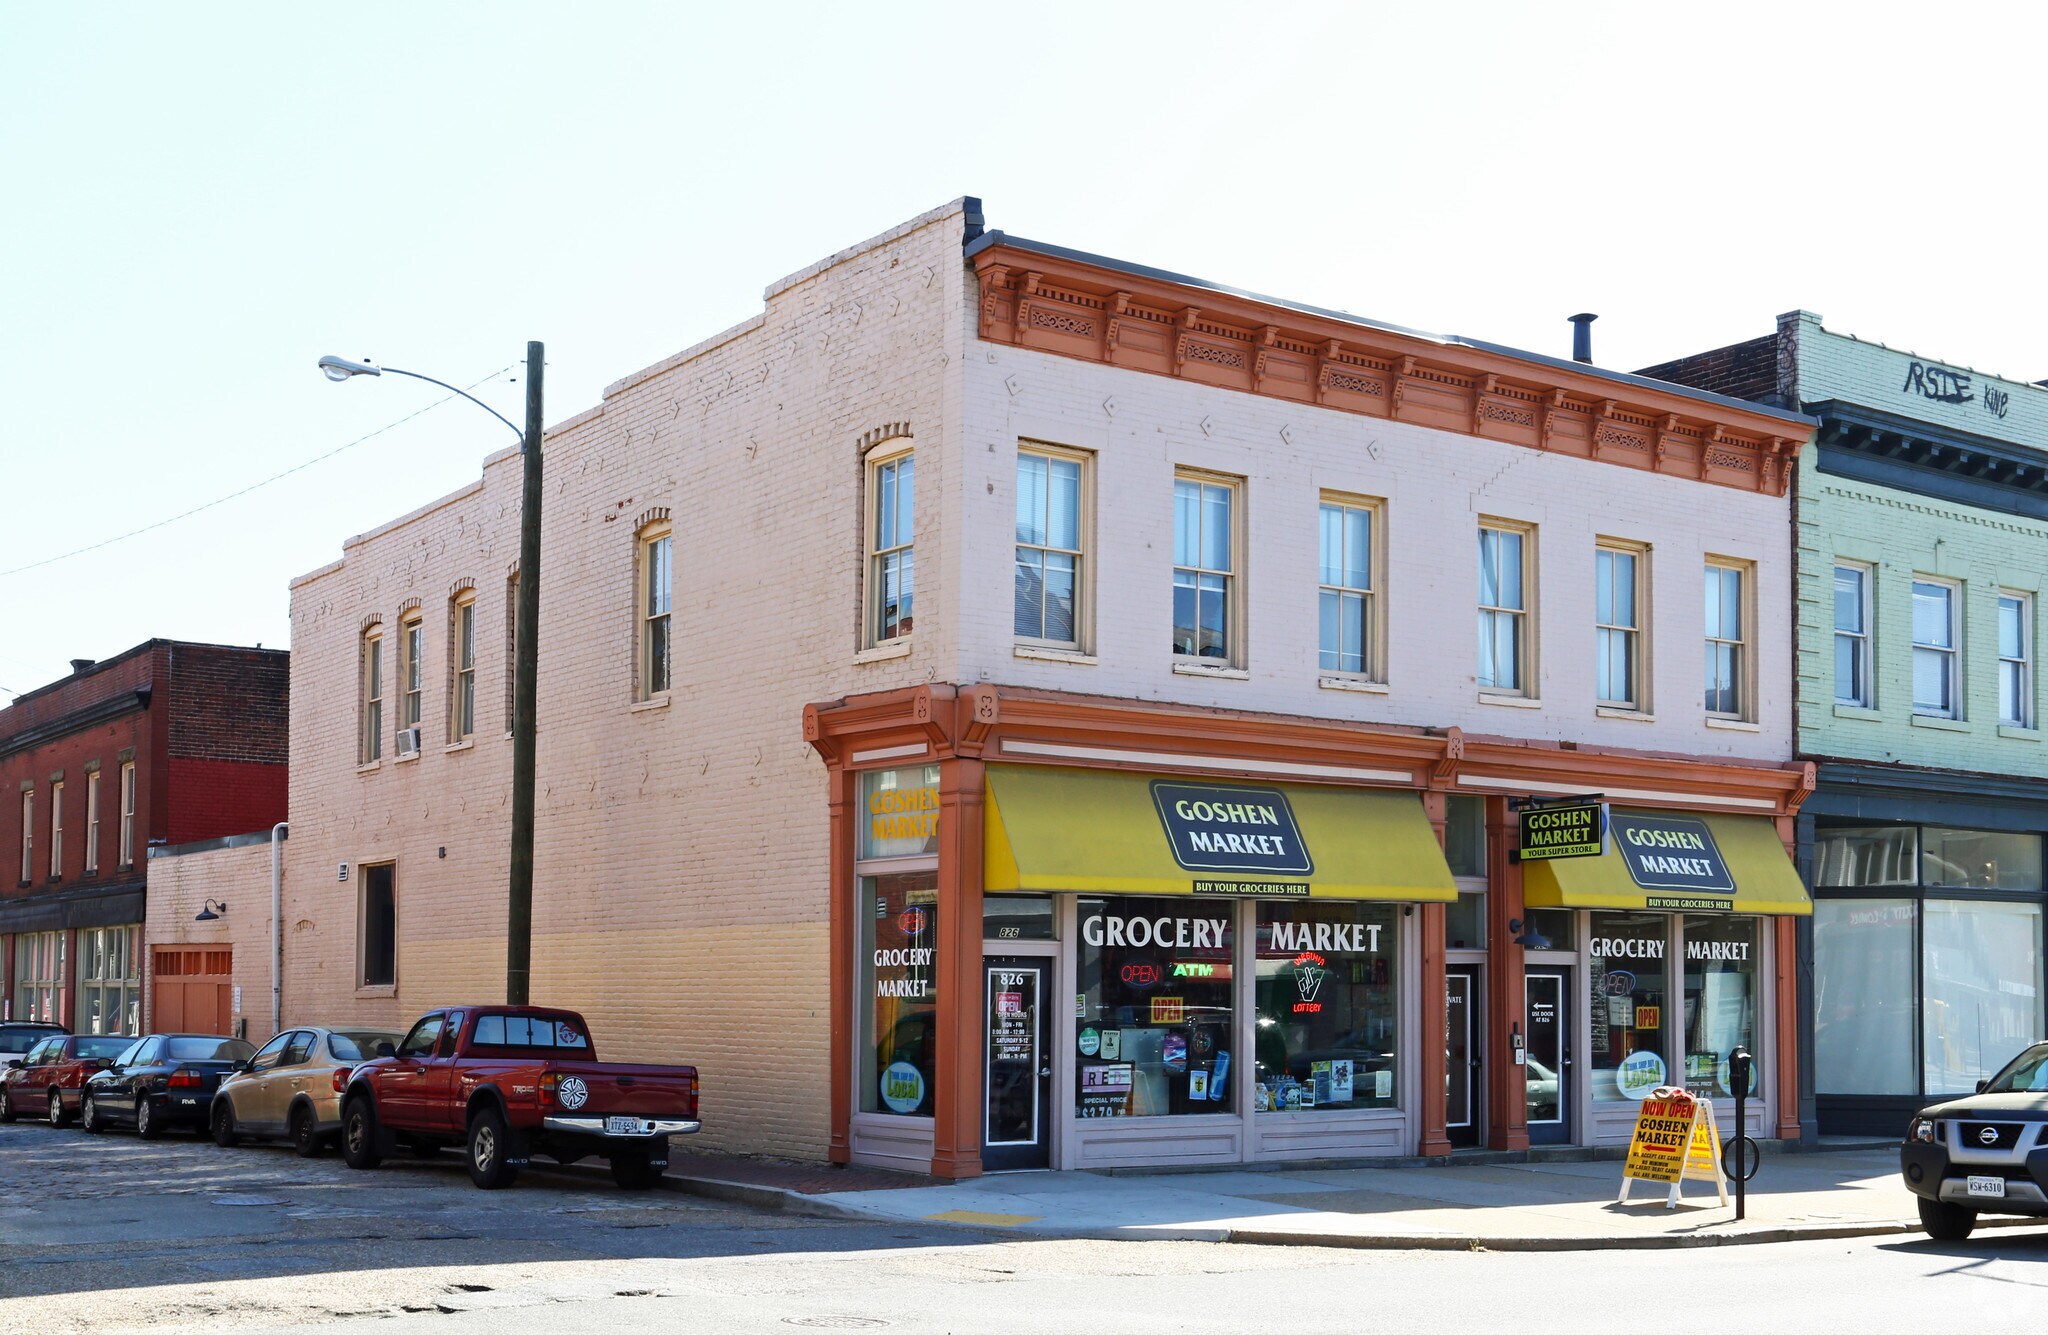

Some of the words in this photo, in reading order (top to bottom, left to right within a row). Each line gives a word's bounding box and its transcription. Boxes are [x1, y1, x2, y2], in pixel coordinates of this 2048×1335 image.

[870, 787, 940, 814] GOSHEN
[1175, 800, 1279, 826] GOSHEN
[1528, 810, 1591, 830] GOSHEN
[871, 813, 939, 841] MARKET
[1530, 827, 1590, 845] MARKET
[1188, 831, 1286, 856] MARKET
[1626, 828, 1705, 851] GOSHEN
[1528, 848, 1547, 857] YOUR
[1548, 847, 1570, 856] SUPER
[1570, 845, 1593, 854] STORE
[1639, 854, 1714, 877] MARKET
[1196, 882, 1214, 892] BUY
[1214, 883, 1238, 893] YOUR
[1239, 884, 1285, 894] GROCERIES
[1286, 885, 1307, 895] HERE
[1648, 898, 1662, 907] BUY
[1662, 899, 1680, 908] YOUR
[1680, 900, 1715, 909] GROCERIES
[1715, 901, 1731, 910] HERE
[1000, 927, 1019, 937] 826
[1083, 915, 1228, 948] GROCERY
[1270, 922, 1382, 952] MARKET
[873, 948, 932, 967] GROCERY
[1589, 938, 1665, 958] GROCERY
[1687, 941, 1749, 960] MARKET
[1293, 951, 1326, 966] VIRGINIA
[1120, 965, 1160, 982] OPEN
[1173, 963, 1213, 976] ATM
[877, 979, 928, 997] MARKET
[1000, 973, 1024, 985] 826
[1598, 974, 1633, 995] OPEN
[998, 1001, 1019, 1012] OPEN
[1153, 999, 1181, 1020] OPEN
[1293, 1003, 1322, 1013] LOTTERY
[1638, 1009, 1658, 1027] OPEN
[887, 1069, 919, 1100] Local
[1642, 1101, 1666, 1116] NOW
[1669, 1103, 1694, 1118] OPEN
[1640, 1119, 1689, 1133] GOSHEN
[1636, 1131, 1685, 1146] MARKET
